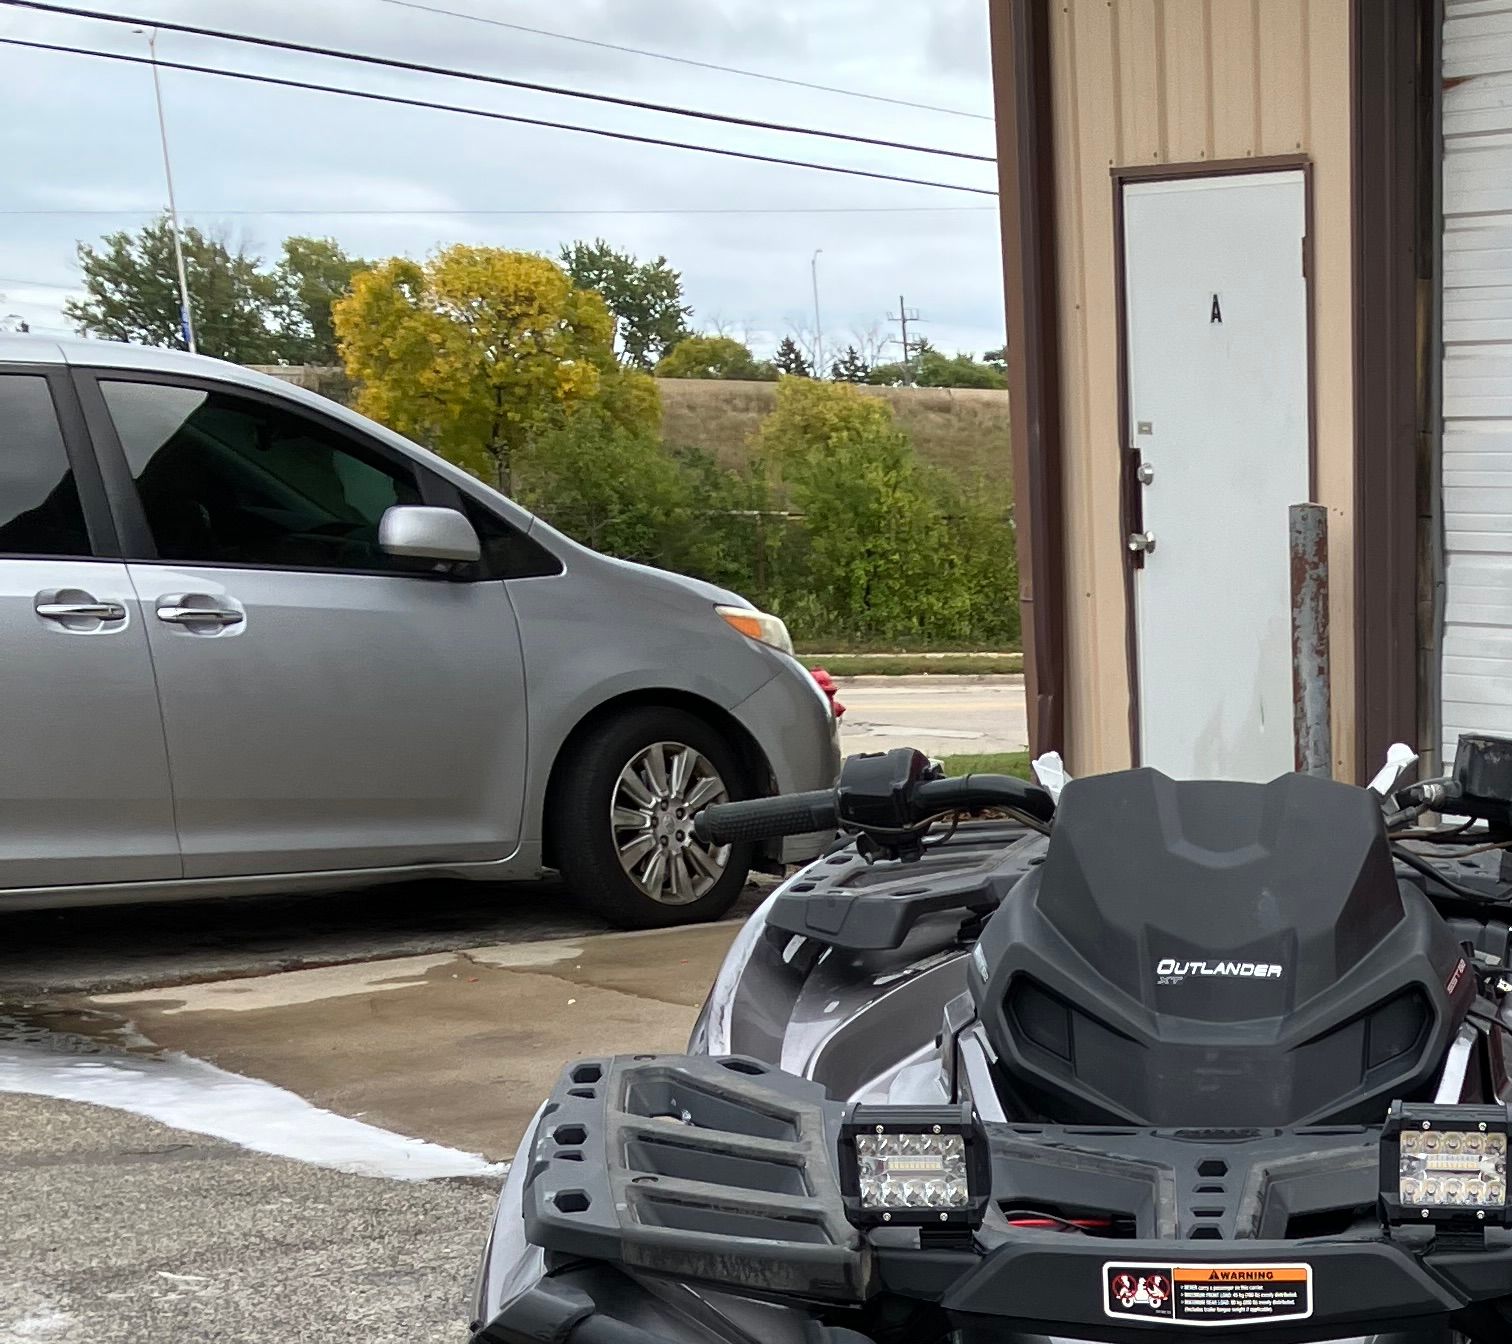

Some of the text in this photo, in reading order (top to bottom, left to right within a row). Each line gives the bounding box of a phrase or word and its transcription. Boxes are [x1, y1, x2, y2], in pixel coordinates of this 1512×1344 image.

[1209, 293, 1223, 323] A
[1156, 957, 1283, 978] OUTLANDER
[1156, 975, 1184, 985] XT
[1220, 1271, 1274, 1280] WARNING
